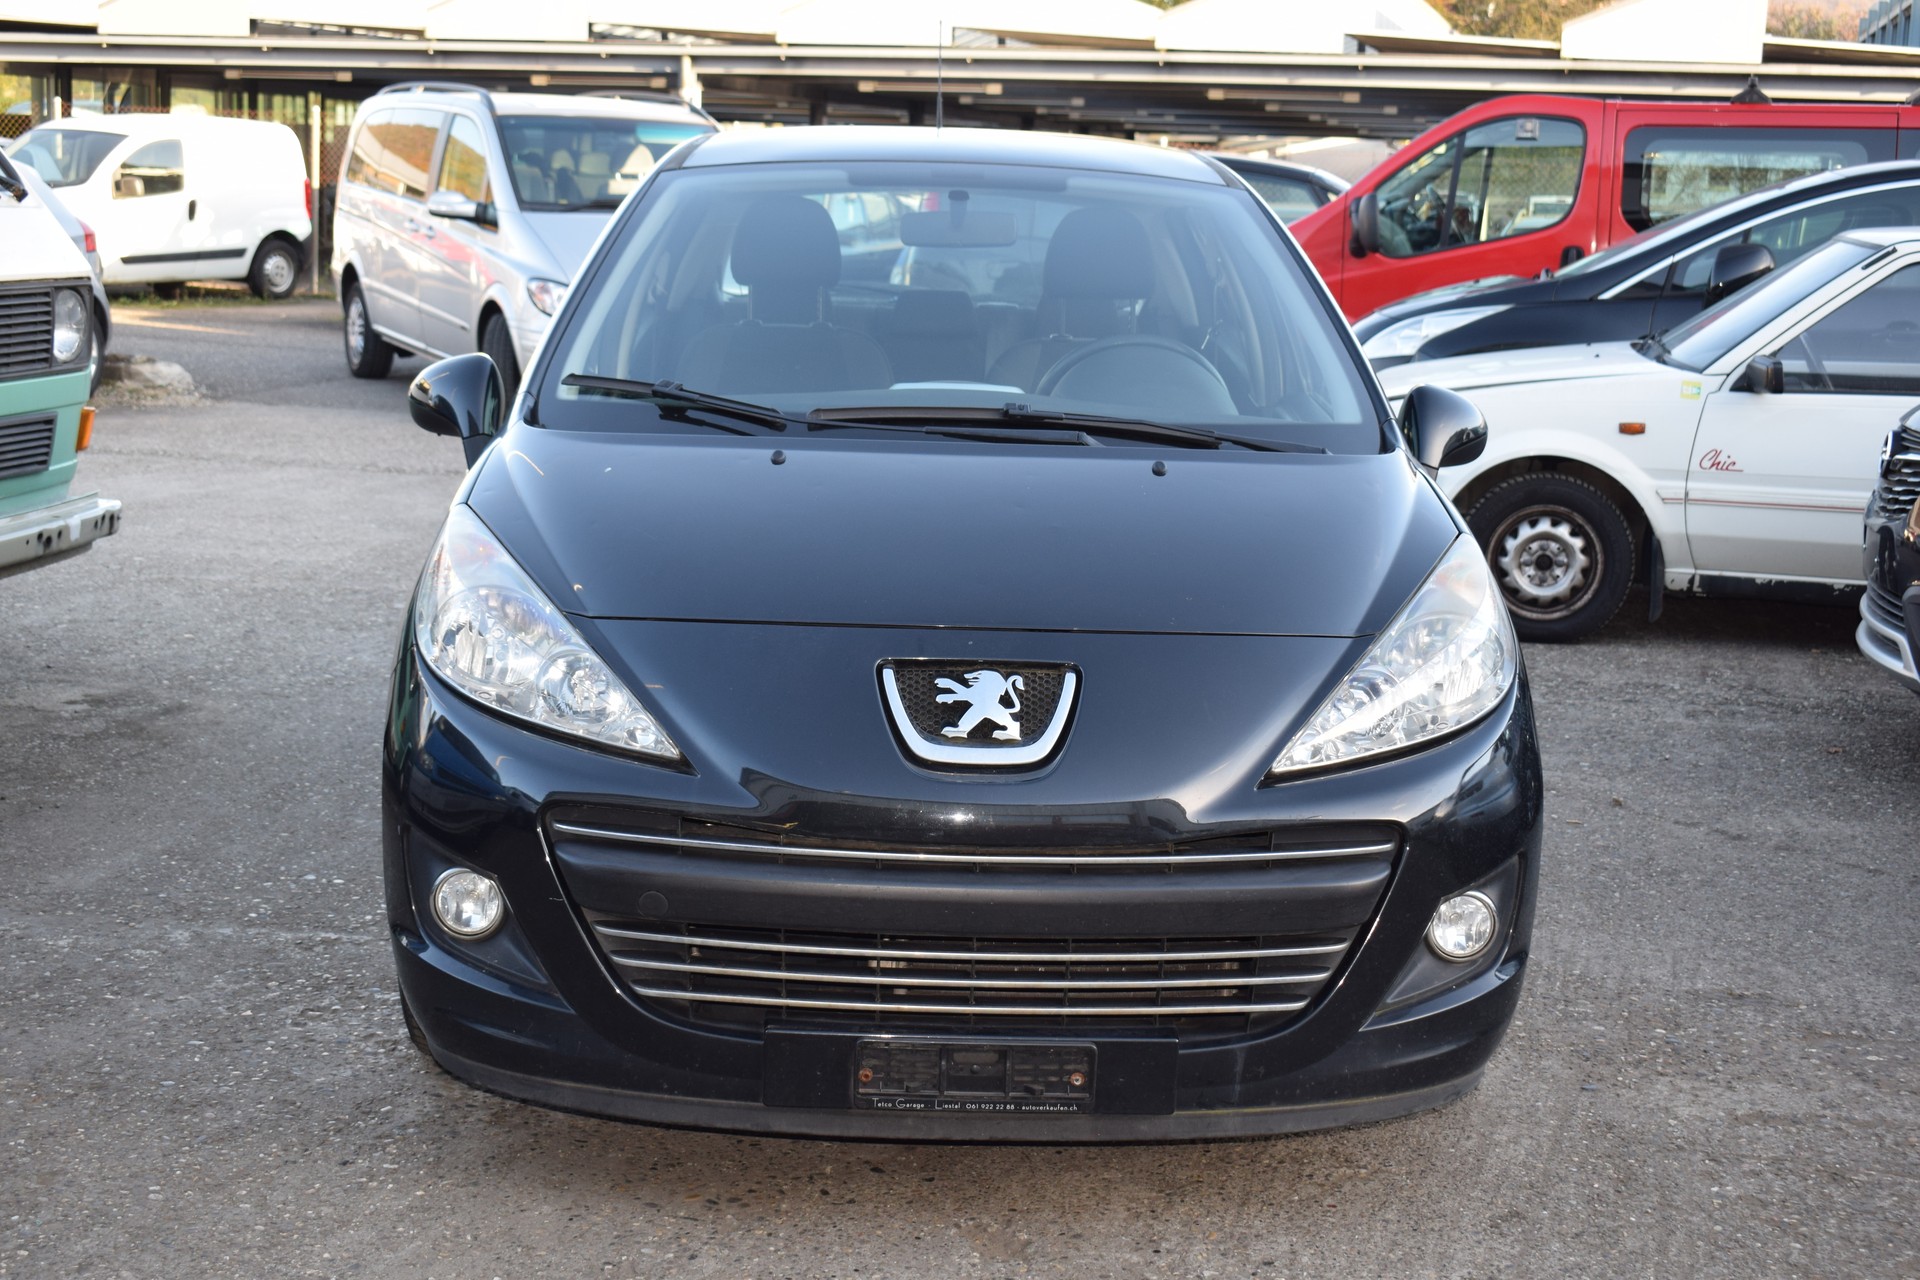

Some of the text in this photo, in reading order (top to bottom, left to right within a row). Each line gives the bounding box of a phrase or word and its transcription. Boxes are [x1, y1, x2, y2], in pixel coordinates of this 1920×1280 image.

[1699, 448, 1744, 472] Chic
[872, 1098, 893, 1108] Tetco
[896, 1098, 925, 1110] Garage
[935, 1099, 961, 1110] Liestal
